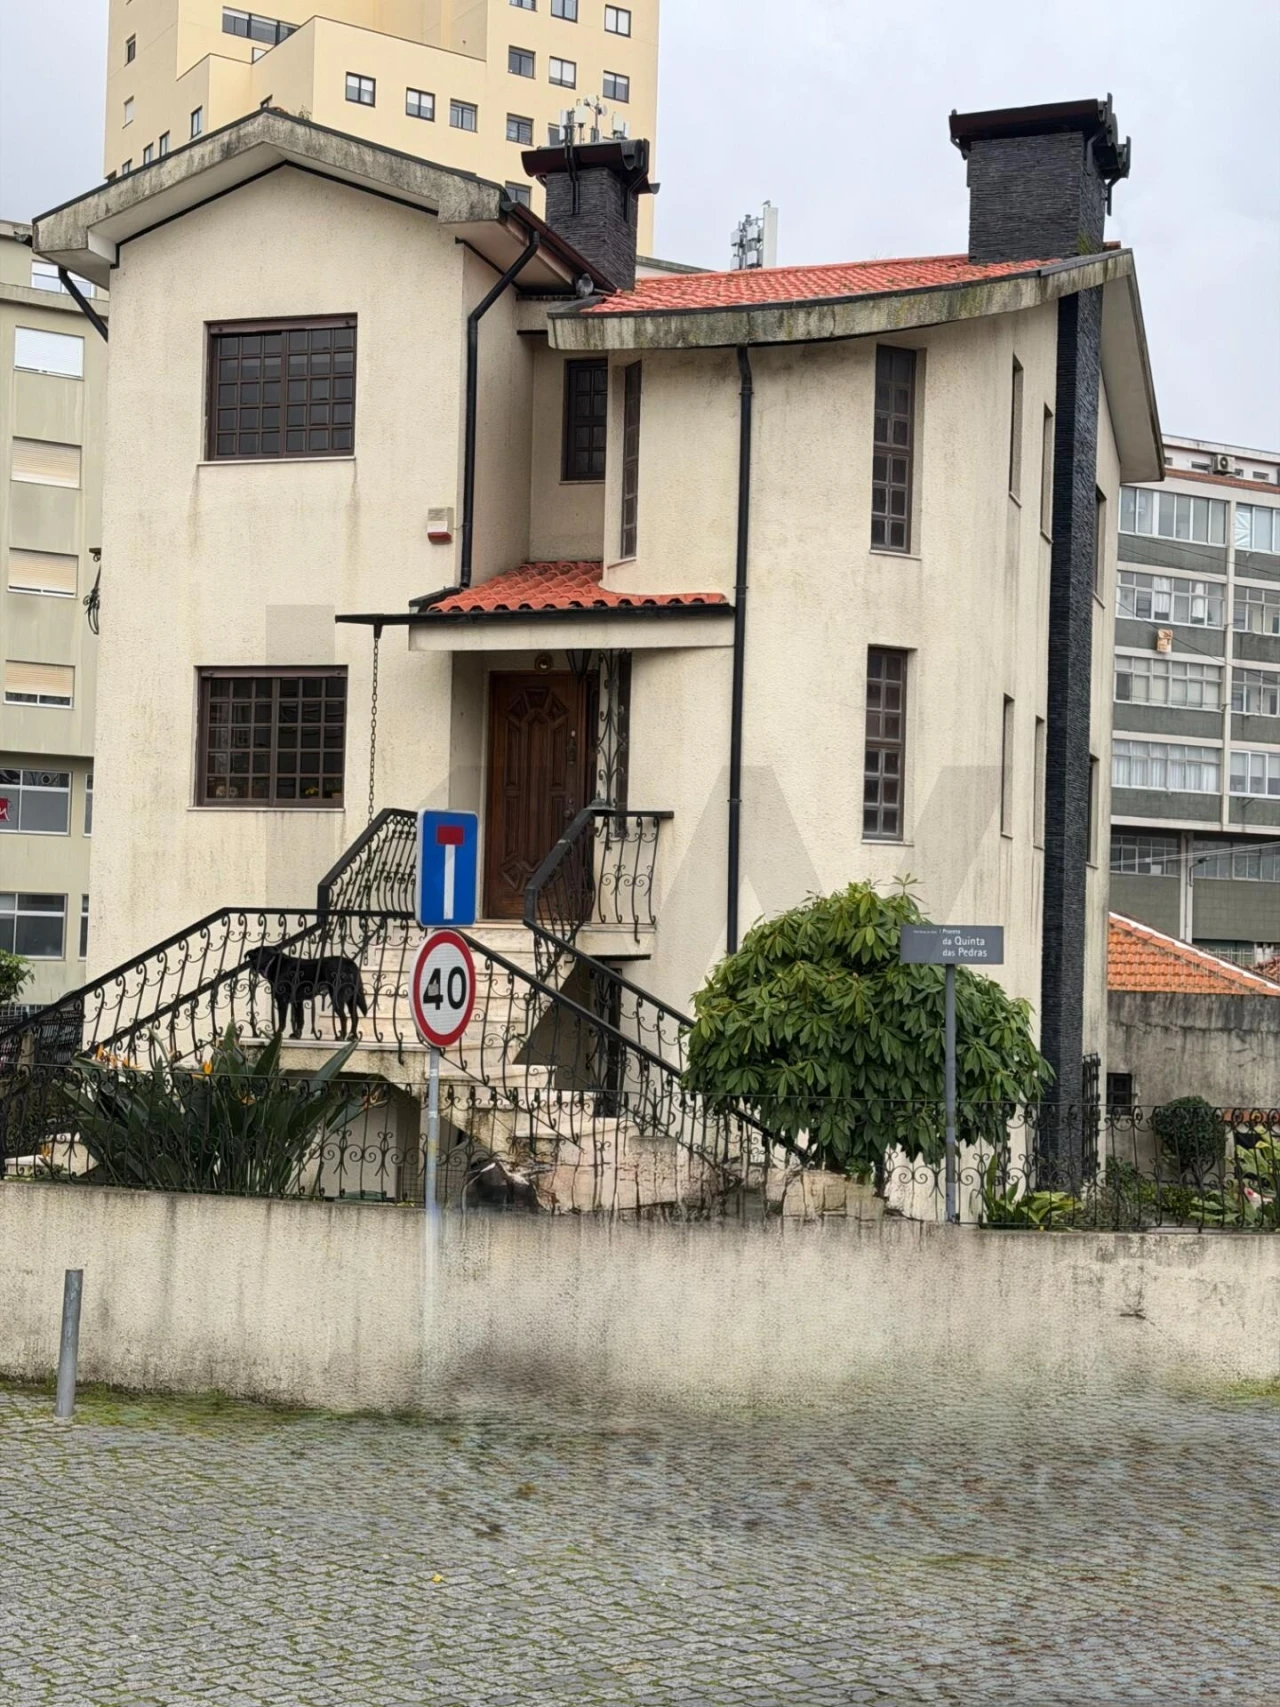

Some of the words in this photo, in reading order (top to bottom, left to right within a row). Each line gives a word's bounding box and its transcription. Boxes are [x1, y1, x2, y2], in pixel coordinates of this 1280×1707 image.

[942, 937, 952, 946] da
[954, 936, 985, 946] Quinta
[942, 948, 955, 957] das
[958, 947, 988, 958] Pedras
[423, 966, 467, 1010] 40
